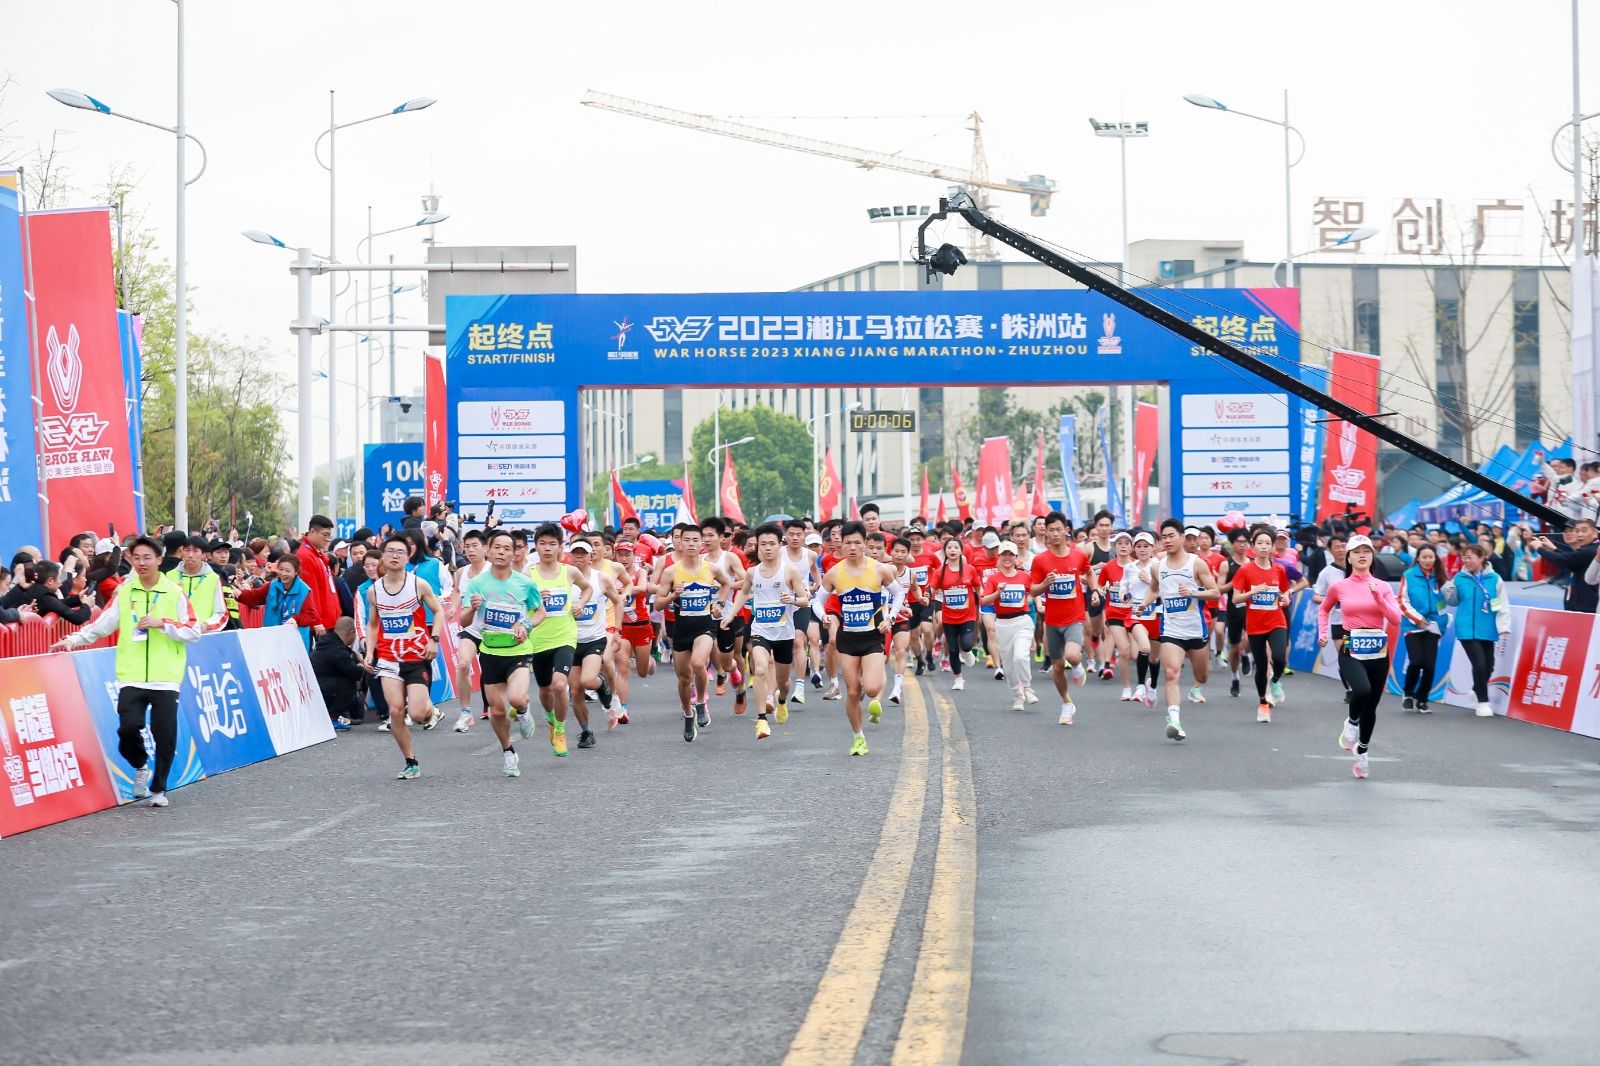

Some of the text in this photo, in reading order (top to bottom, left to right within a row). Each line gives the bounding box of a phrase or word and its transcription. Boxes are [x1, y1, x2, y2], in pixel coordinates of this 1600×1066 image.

[468, 322, 554, 351] 起终点
[654, 347, 690, 358] WAR
[694, 347, 747, 357] HORSE
[751, 347, 789, 357] 2023
[794, 347, 845, 357] XIANG
[850, 346, 898, 357] JIANG
[1008, 345, 1088, 355] ZHUZHOU
[467, 352, 555, 365] START/FINISH
[853, 414, 912, 428] 0:00:06
[630, 494, 682, 510] 跑方阵
[545, 596, 565, 606] 1453
[681, 598, 707, 609] B1455
[842, 594, 871, 603] 42.195
[486, 609, 516, 624] B1590
[756, 608, 782, 619] B1652
[843, 612, 870, 623] B1449
[382, 617, 410, 630] B1534
[1352, 638, 1383, 649] B2234
